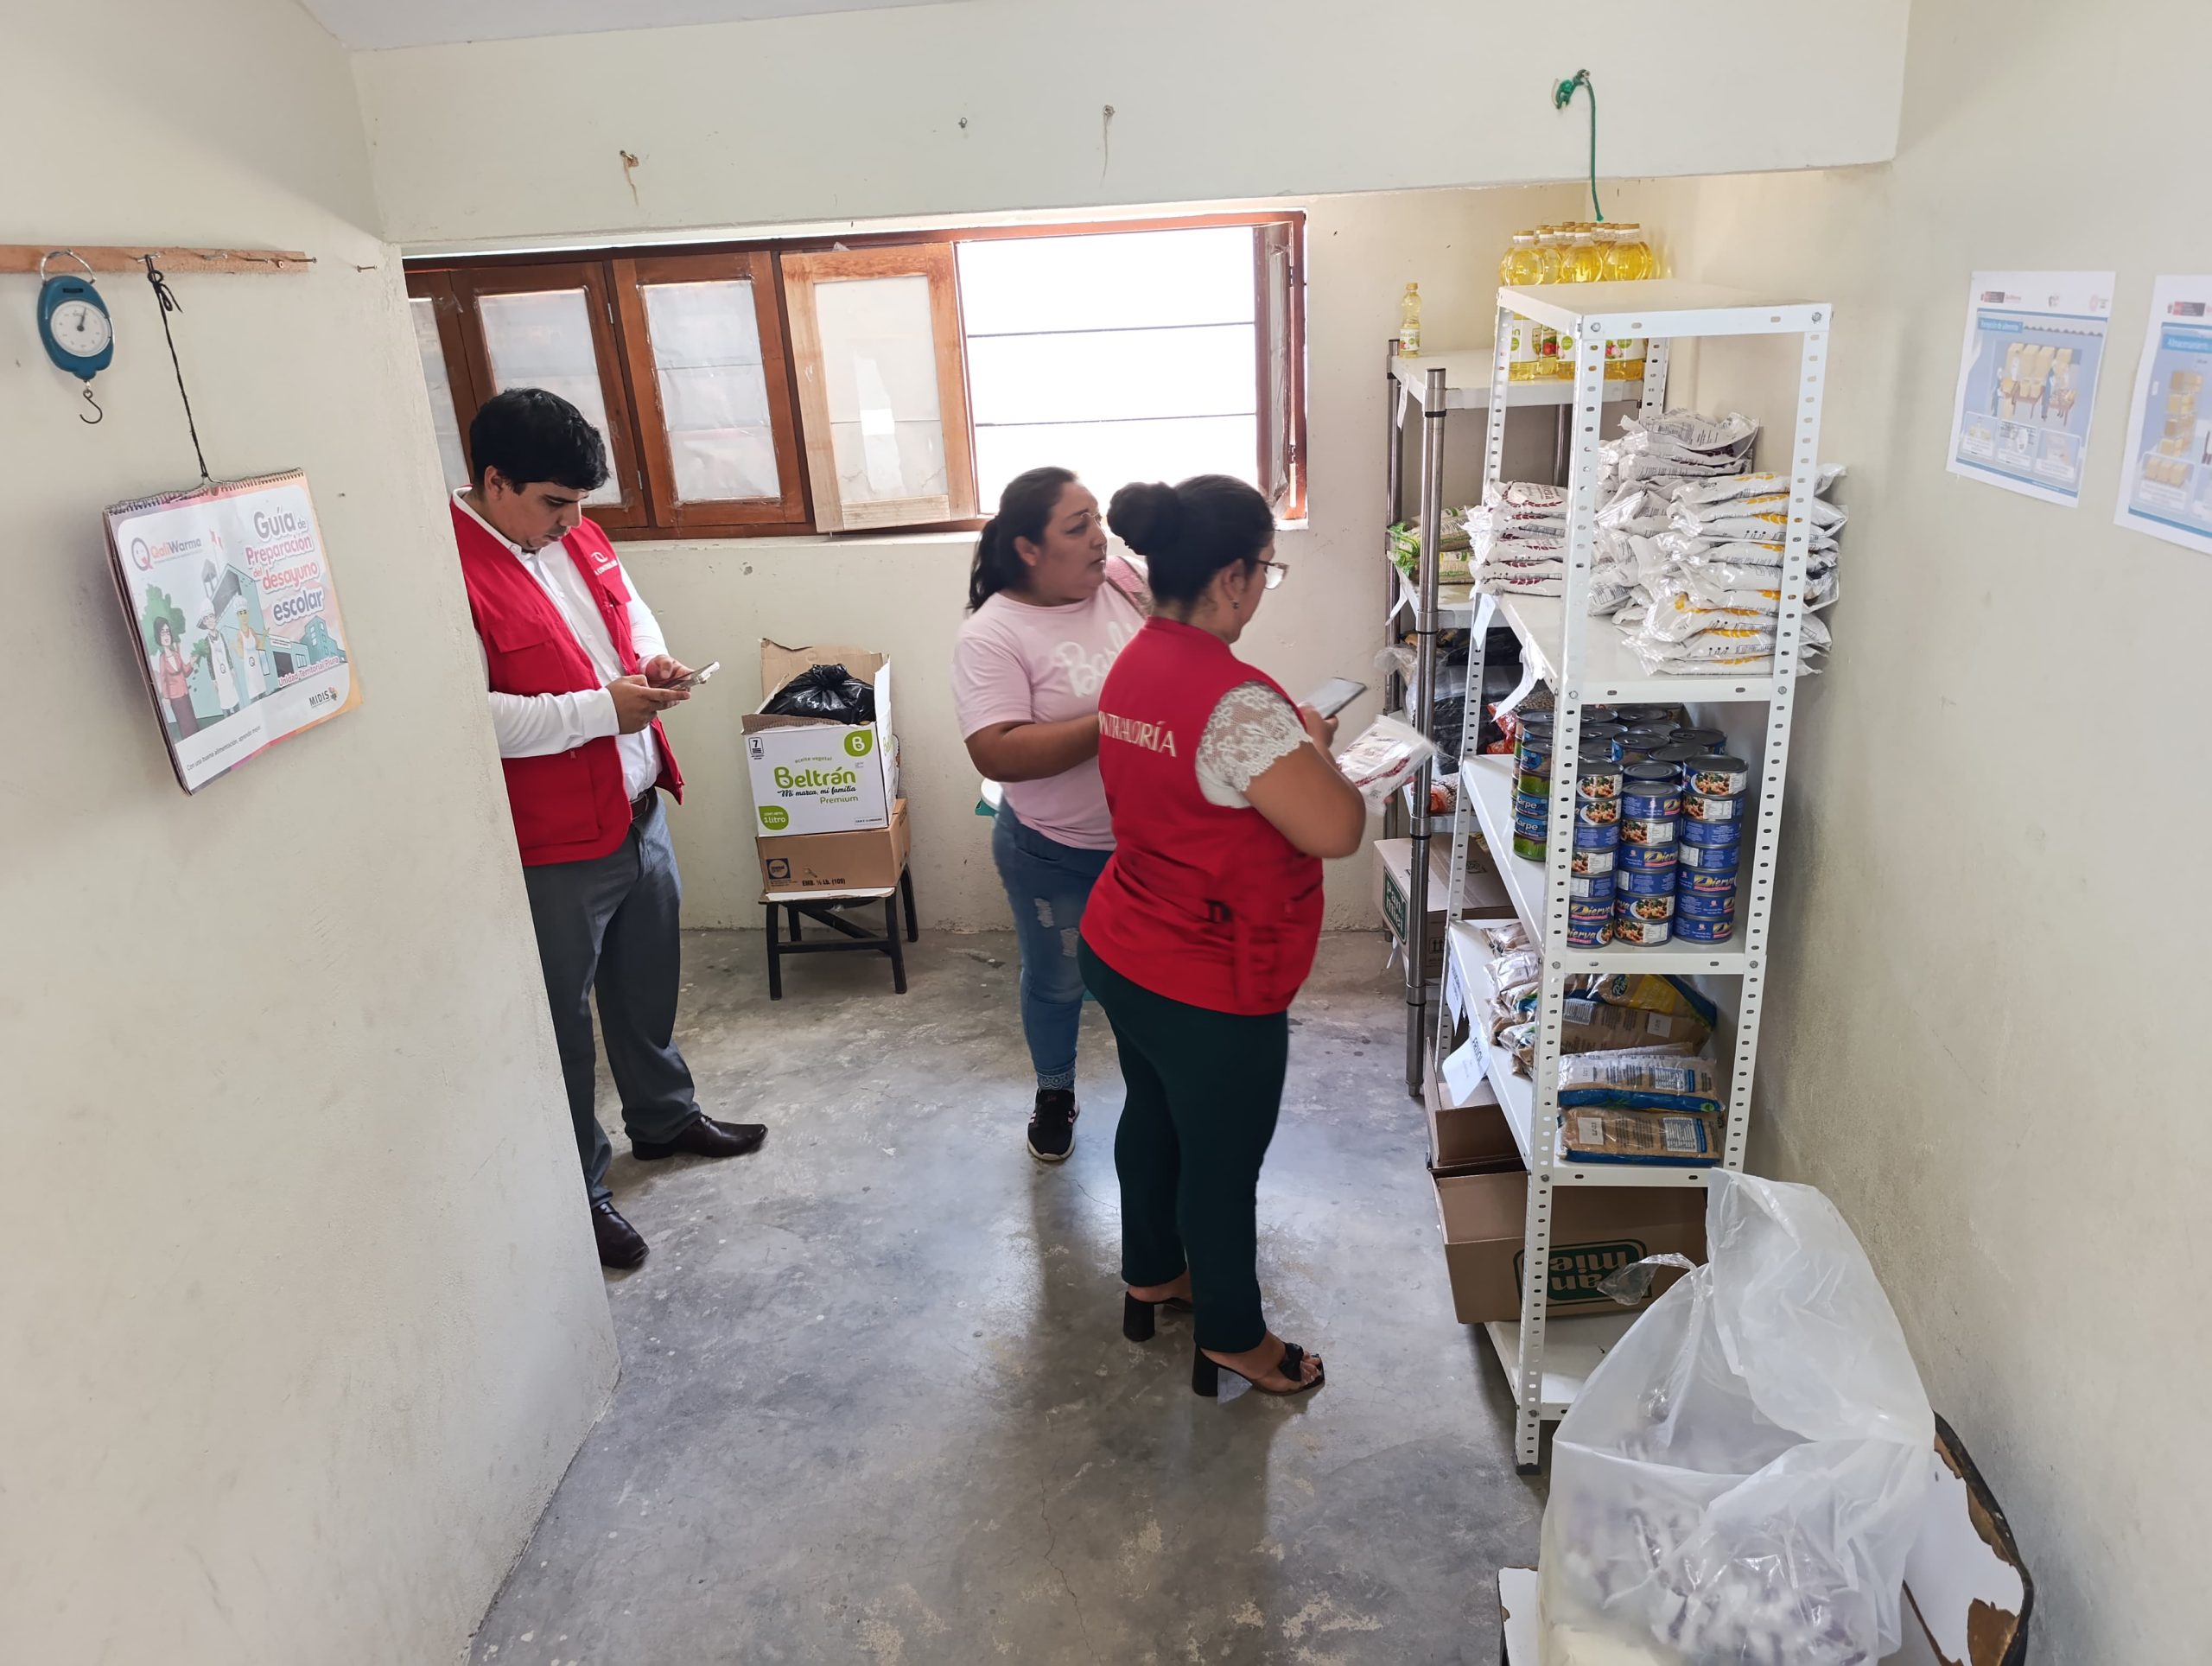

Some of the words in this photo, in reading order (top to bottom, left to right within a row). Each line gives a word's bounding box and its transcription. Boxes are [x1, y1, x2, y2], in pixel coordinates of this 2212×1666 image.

[253, 506, 296, 539] Guía
[245, 534, 313, 566] Preparación
[263, 562, 319, 590] desayuno
[273, 590, 322, 621] escolar
[308, 690, 330, 706] MIDIS
[852, 736, 865, 751] B
[774, 766, 856, 789] Beltrán
[820, 796, 858, 804] Premium
[1549, 1251, 1627, 1273] mie
[1551, 1274, 1603, 1291] an
